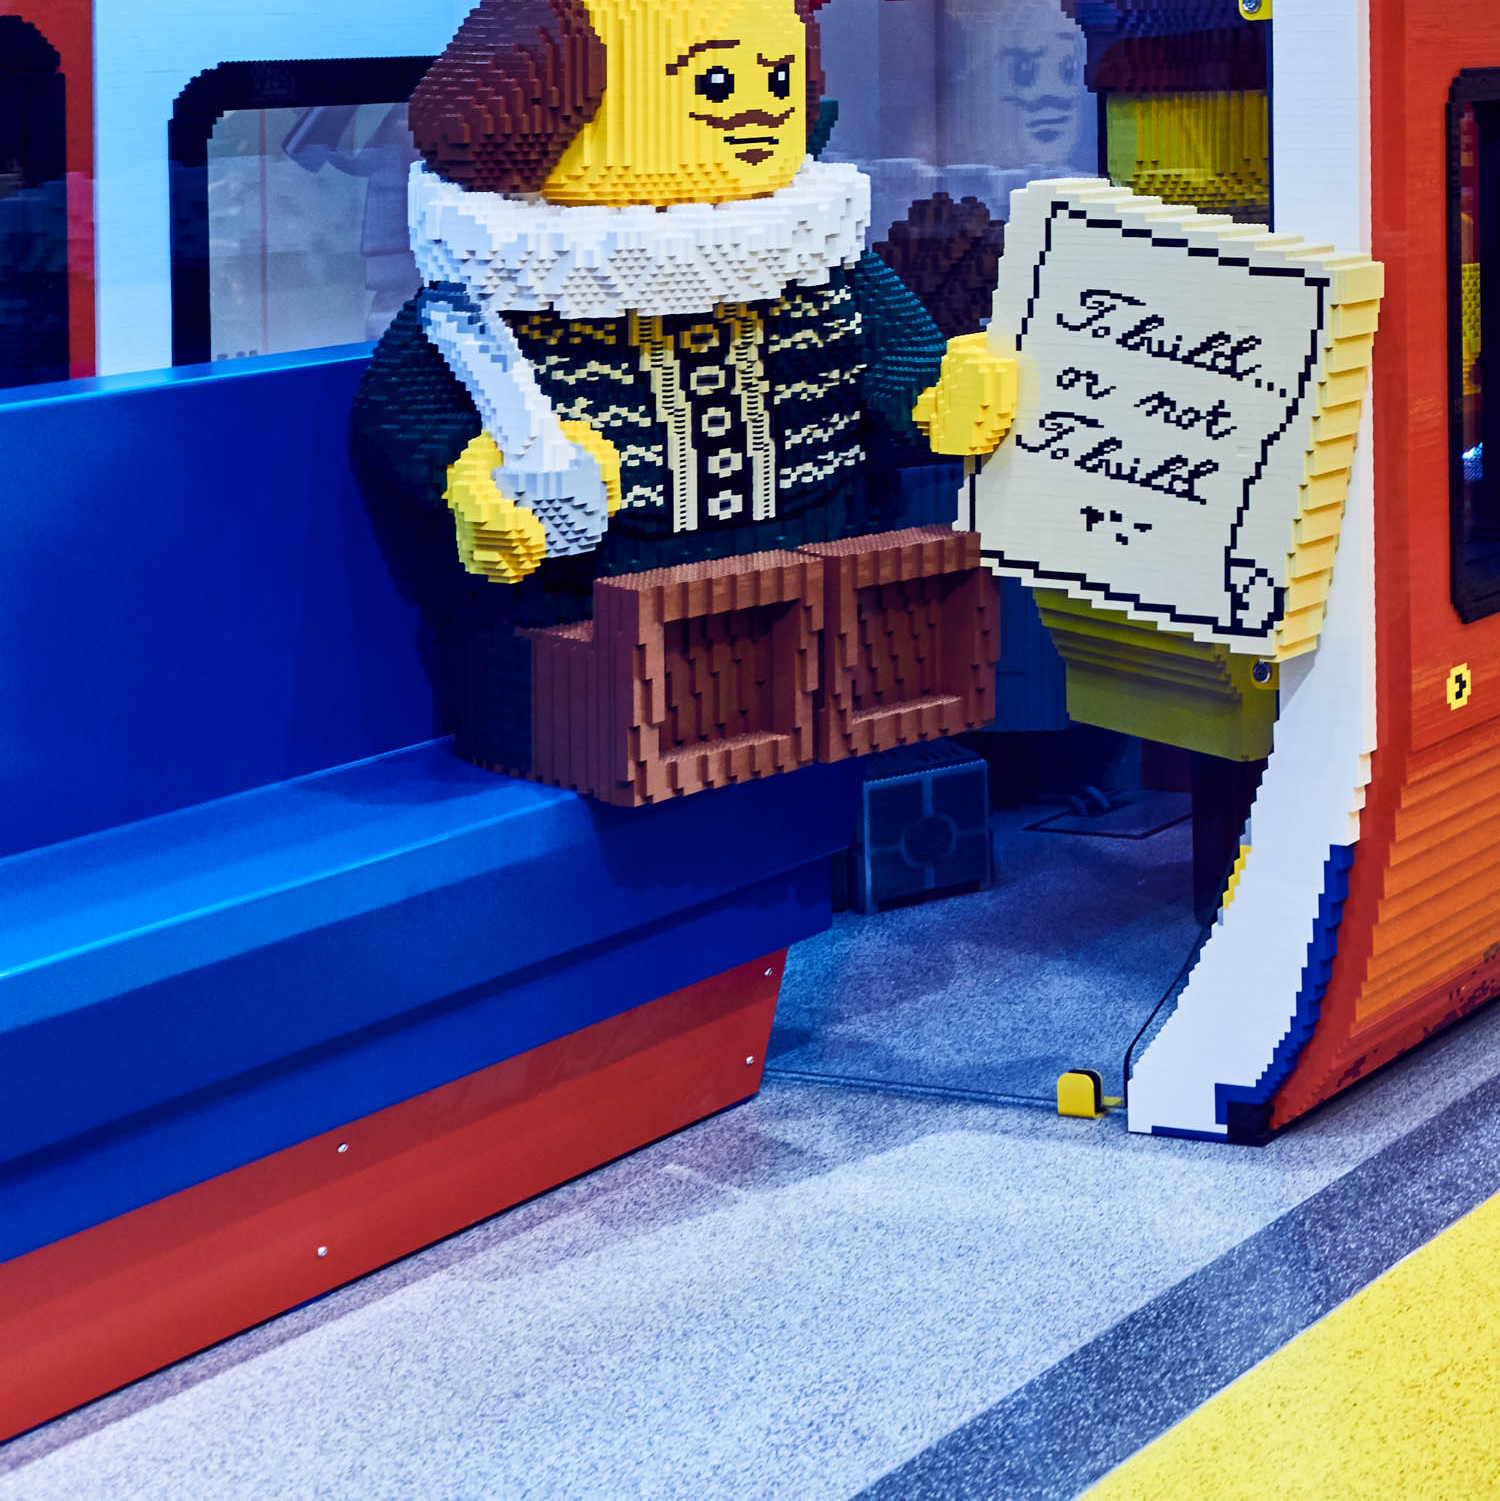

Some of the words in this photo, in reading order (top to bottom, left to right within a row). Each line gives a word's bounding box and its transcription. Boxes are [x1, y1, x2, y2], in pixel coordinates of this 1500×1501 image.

[1056, 367, 1117, 399] or
[1134, 391, 1237, 439] not
[1074, 437, 1219, 506] build
